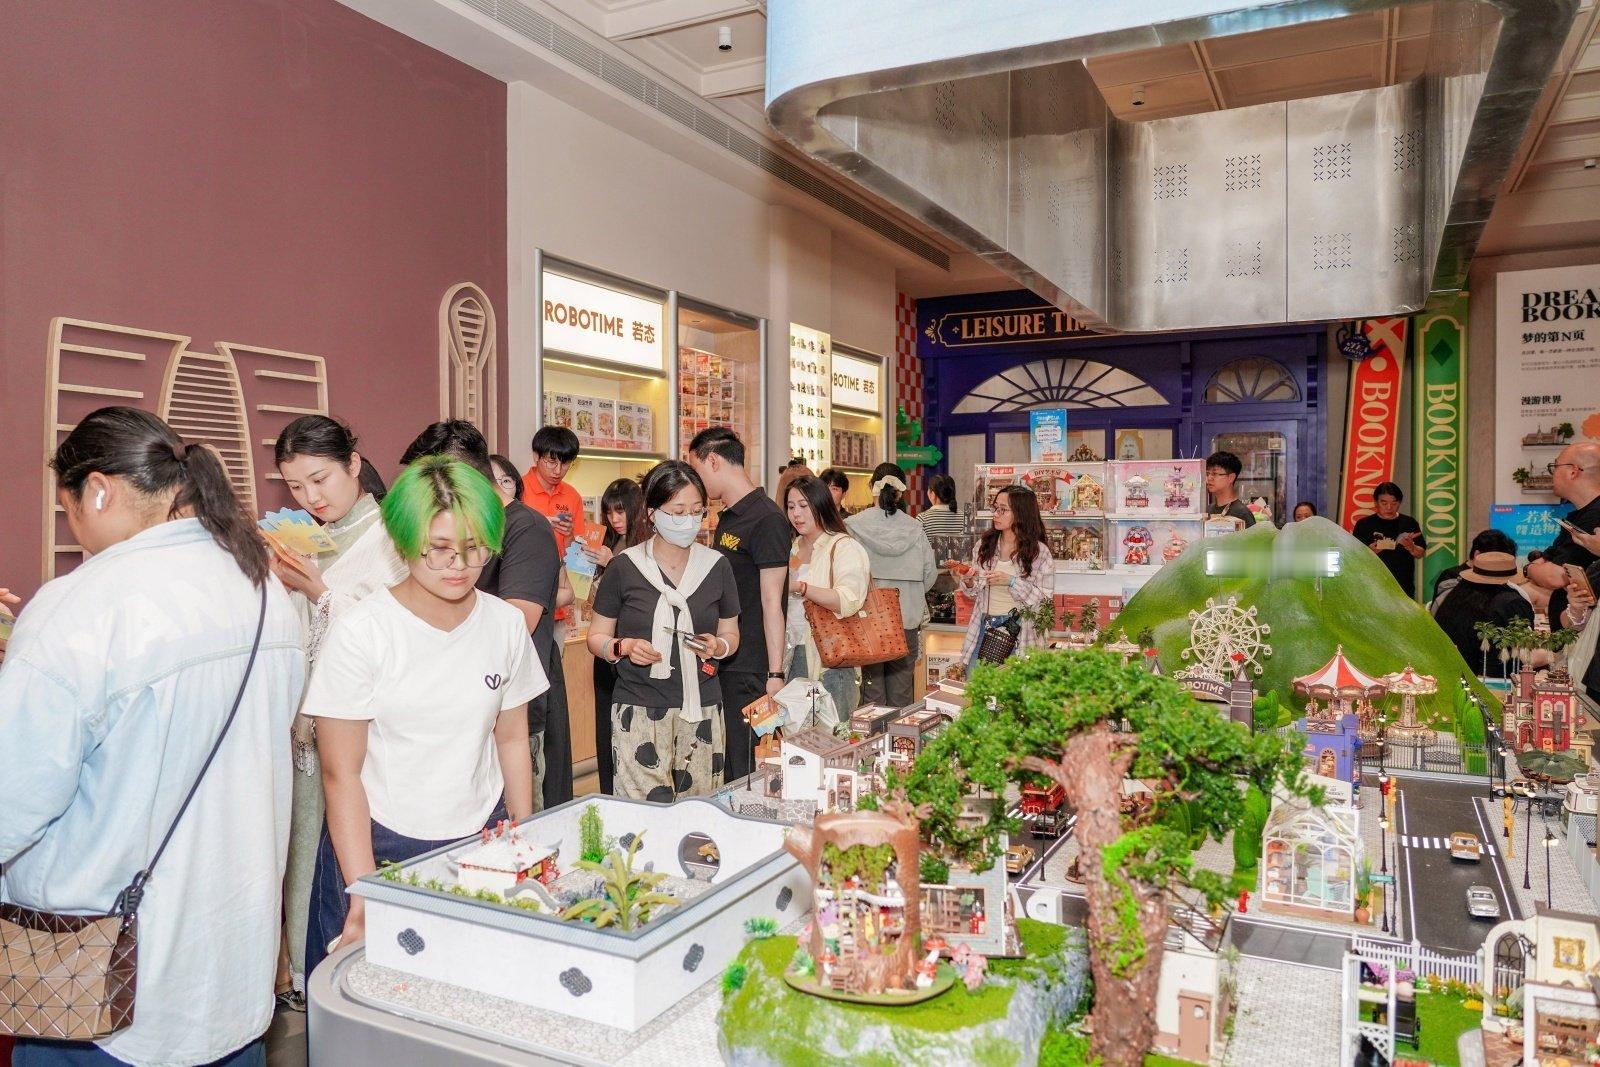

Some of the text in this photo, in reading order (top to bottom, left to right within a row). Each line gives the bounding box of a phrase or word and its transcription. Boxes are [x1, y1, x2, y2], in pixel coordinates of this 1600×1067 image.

[1521, 288, 1600, 308] DREA
[545, 300, 655, 344] ROBOTIME 若态
[961, 313, 1046, 338] LEISURE
[831, 373, 874, 394] BOTIME 若态
[1426, 382, 1457, 557] BOOKNOOK
